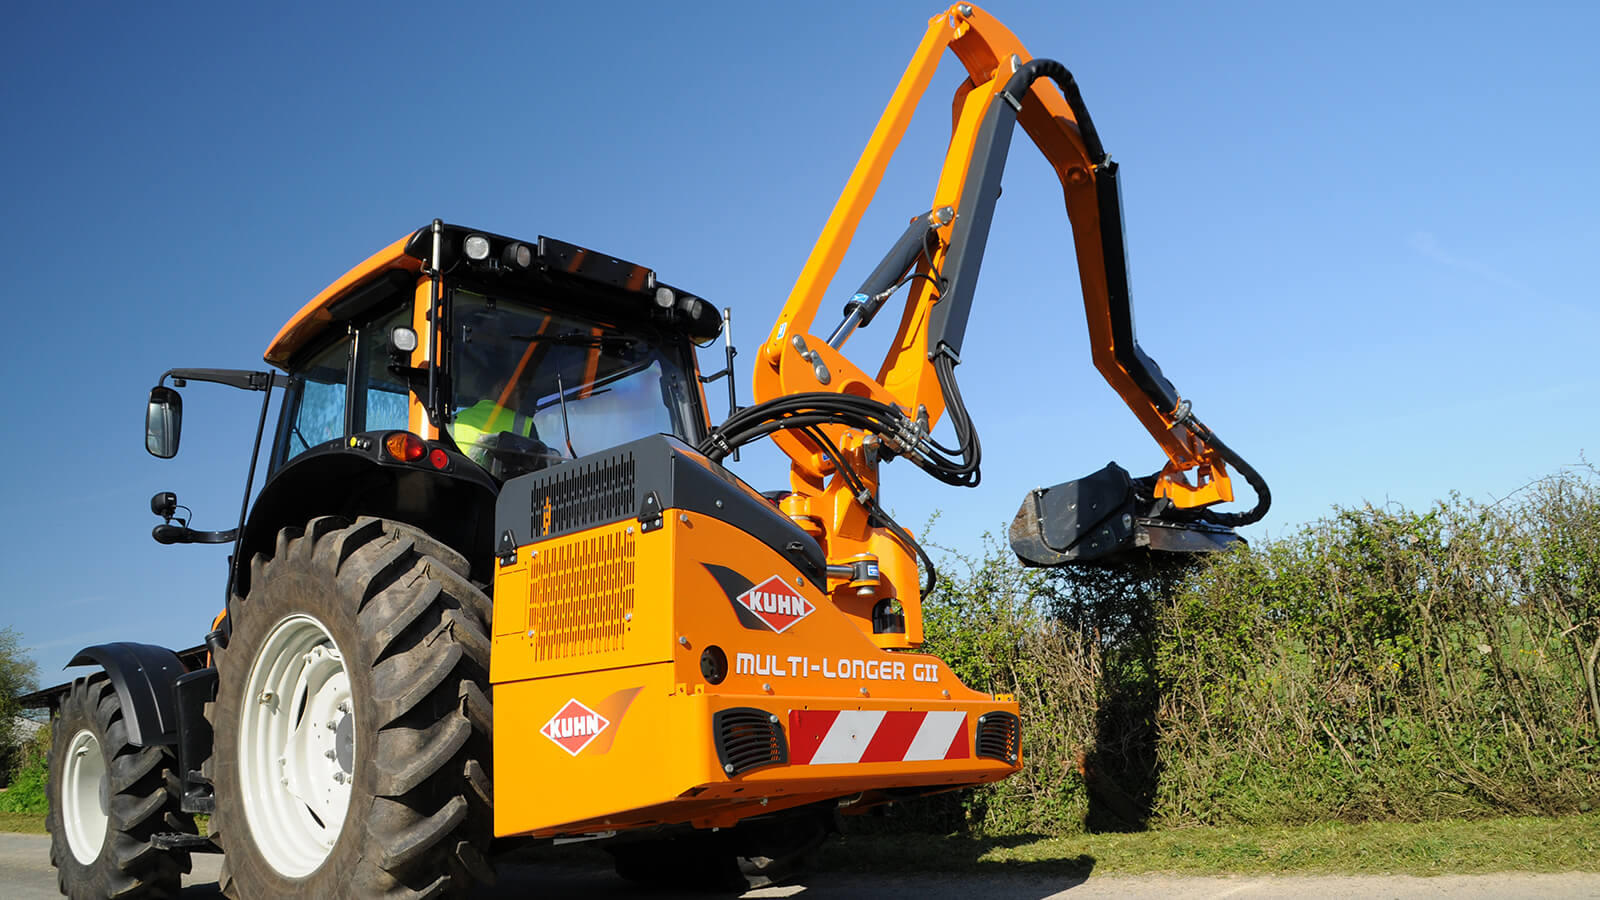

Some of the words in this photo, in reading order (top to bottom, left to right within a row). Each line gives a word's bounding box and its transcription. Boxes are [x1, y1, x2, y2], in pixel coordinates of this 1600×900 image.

[749, 590, 806, 617] KUHN
[736, 652, 906, 680] MULTI-LONGER
[913, 663, 939, 682] GII
[550, 713, 599, 739] KUHN
